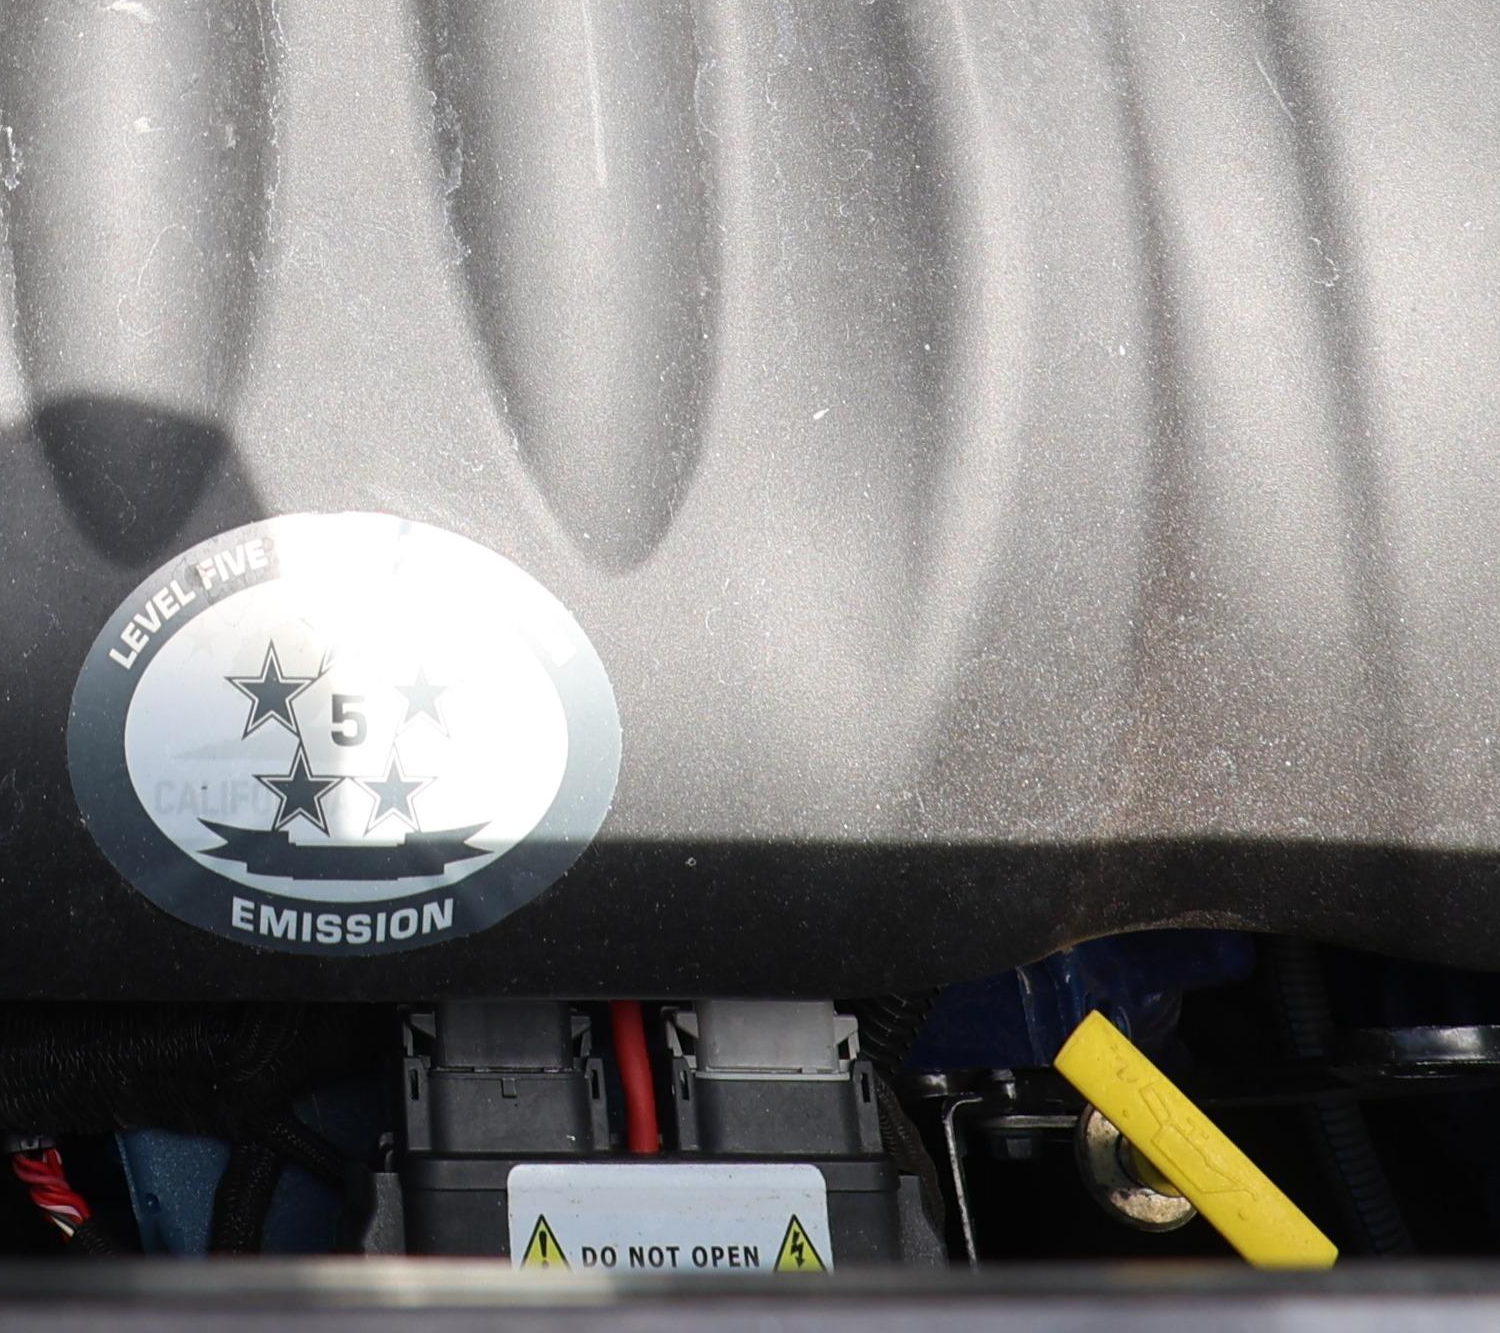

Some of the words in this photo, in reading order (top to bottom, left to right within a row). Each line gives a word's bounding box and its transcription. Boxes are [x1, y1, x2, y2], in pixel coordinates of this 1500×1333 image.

[108, 577, 197, 670] LEVEL
[195, 539, 271, 591] FIVE
[329, 693, 368, 748] 5
[231, 896, 455, 945] EMISSION
[581, 1245, 618, 1268] DO
[629, 1245, 680, 1269] NOT
[691, 1245, 760, 1269] OPEN
